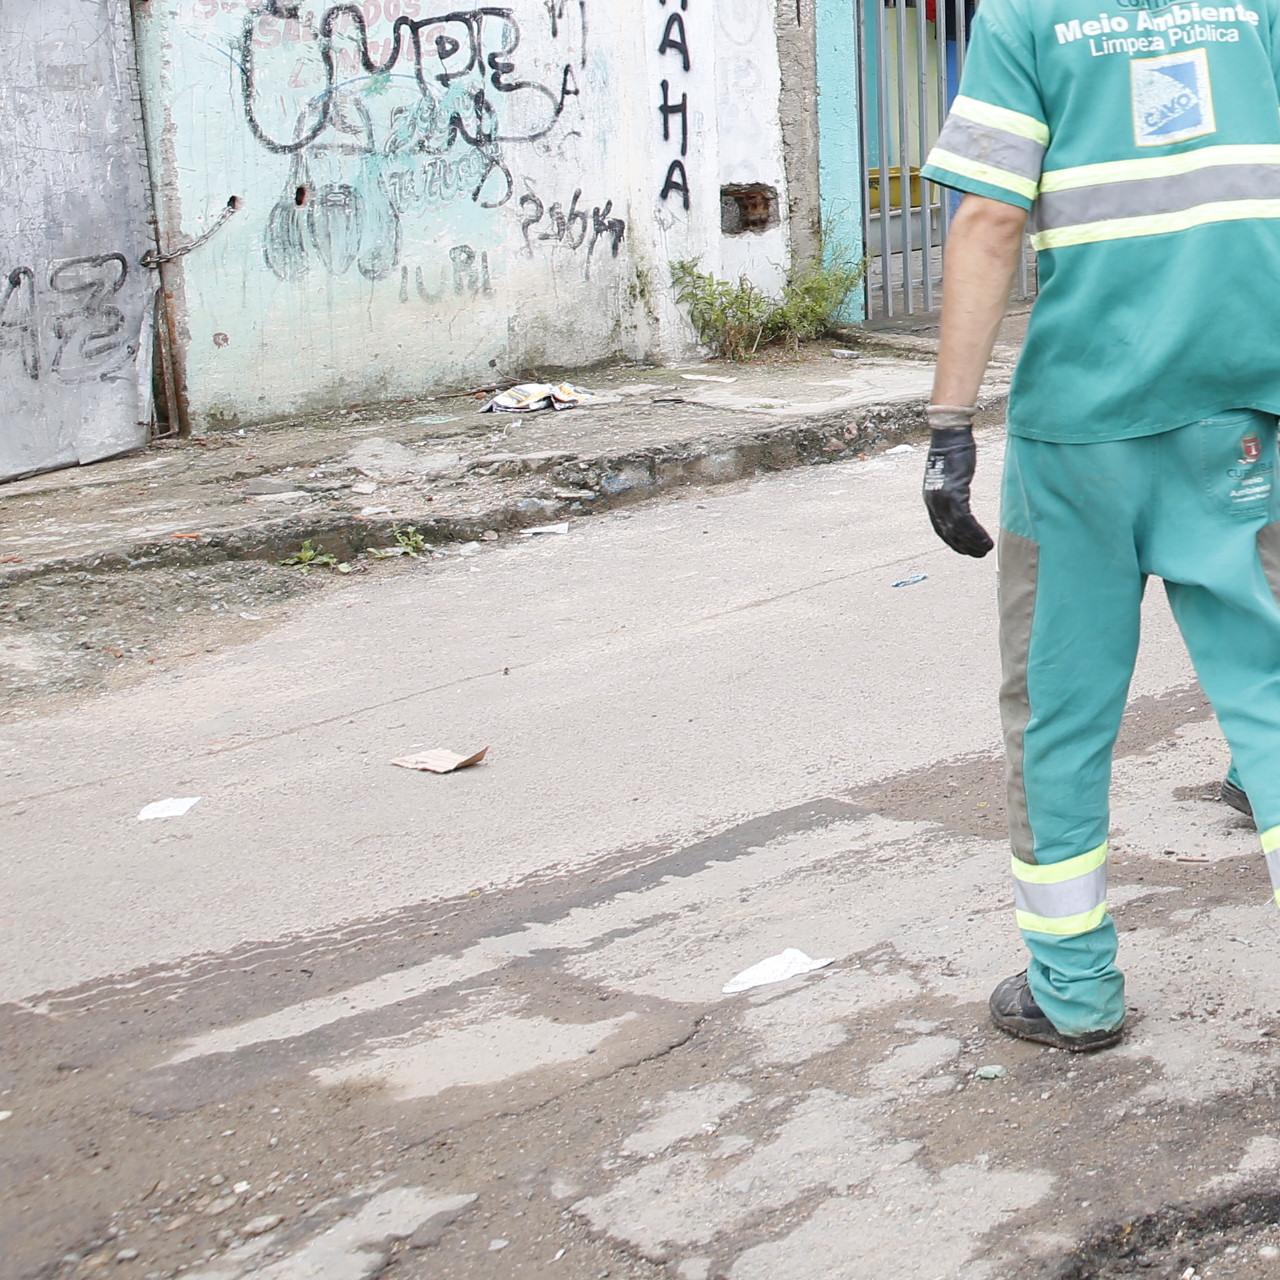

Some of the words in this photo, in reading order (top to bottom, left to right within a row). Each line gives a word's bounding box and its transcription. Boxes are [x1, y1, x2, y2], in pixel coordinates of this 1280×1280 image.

[1054, 13, 1129, 44] Meio
[1136, 3, 1260, 32] Ambiente
[1168, 24, 1240, 47] Pública
[1144, 92, 1192, 128] CAVO
